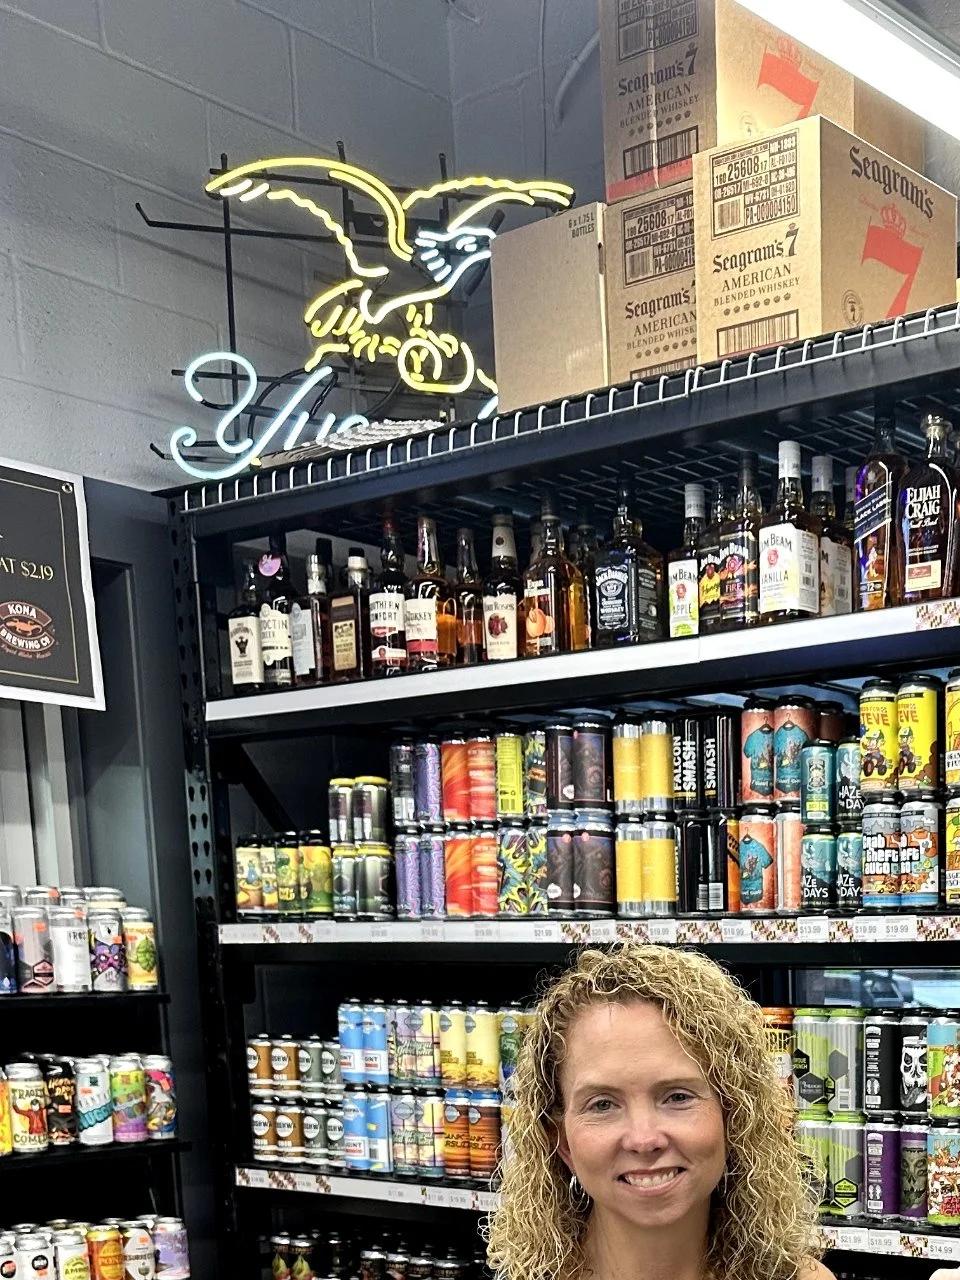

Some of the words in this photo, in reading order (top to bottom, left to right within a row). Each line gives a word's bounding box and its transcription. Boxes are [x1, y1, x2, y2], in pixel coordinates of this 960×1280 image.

[627, 81, 692, 114] AMERICAN
[849, 145, 934, 220] Seagram's
[572, 223, 595, 238] BOTTLES
[712, 239, 784, 275] Seagram's
[784, 229, 799, 257] 7
[722, 263, 791, 293] AMERICAN
[625, 288, 690, 319] Seagram's
[714, 287, 755, 307] BLENDED
[758, 276, 800, 298] WHISKEY
[906, 485, 940, 504] ELIJAH
[905, 500, 940, 518] CRAIG
[21, 562, 54, 581] $2.19
[726, 583, 741, 592] FIRE
[8, 603, 37, 619] KONA
[674, 735, 682, 790] FALCON
[683, 741, 696, 792] SMASH
[706, 738, 716, 788] SMASH
[867, 847, 898, 862] theft
[804, 888, 828, 898] DAYS
[798, 925, 822, 934] $13.99
